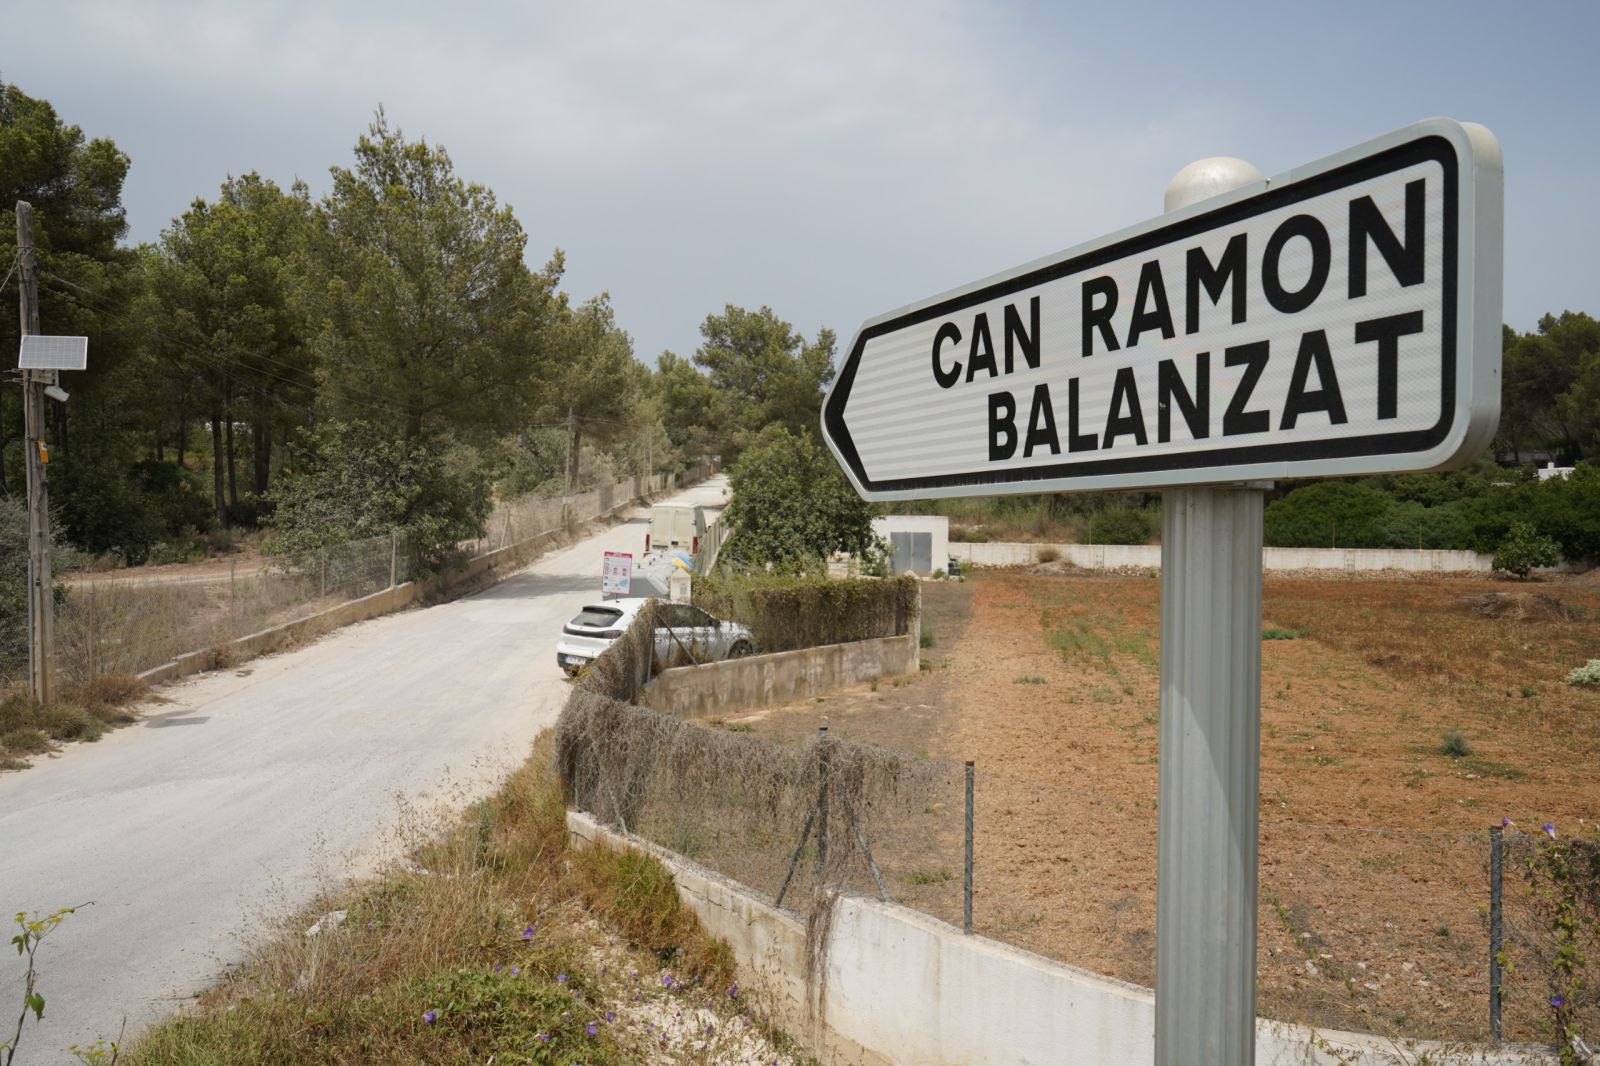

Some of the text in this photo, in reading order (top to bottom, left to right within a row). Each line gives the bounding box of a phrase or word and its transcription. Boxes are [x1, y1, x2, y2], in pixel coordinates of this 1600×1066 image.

[931, 178, 1426, 389] CAN RAMON
[988, 310, 1424, 462] BALANZAT
